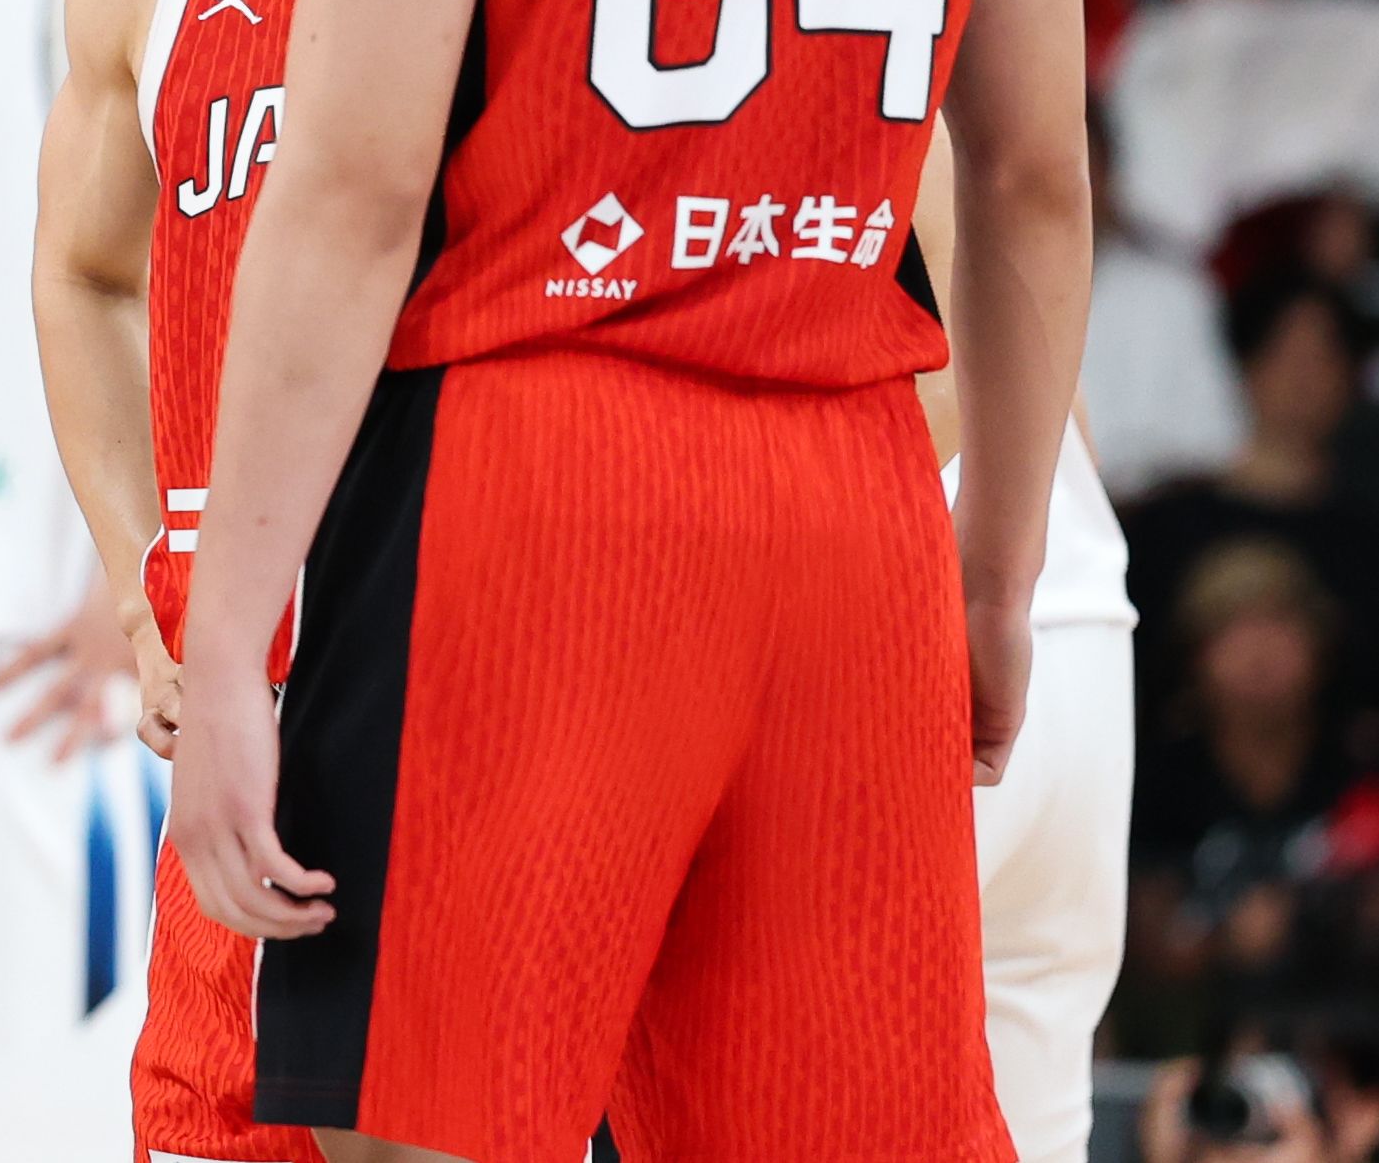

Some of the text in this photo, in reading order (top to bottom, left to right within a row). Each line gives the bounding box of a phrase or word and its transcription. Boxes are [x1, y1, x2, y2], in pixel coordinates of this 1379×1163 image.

[671, 194, 895, 269] 日本生命
[545, 277, 638, 301] NISSAY
